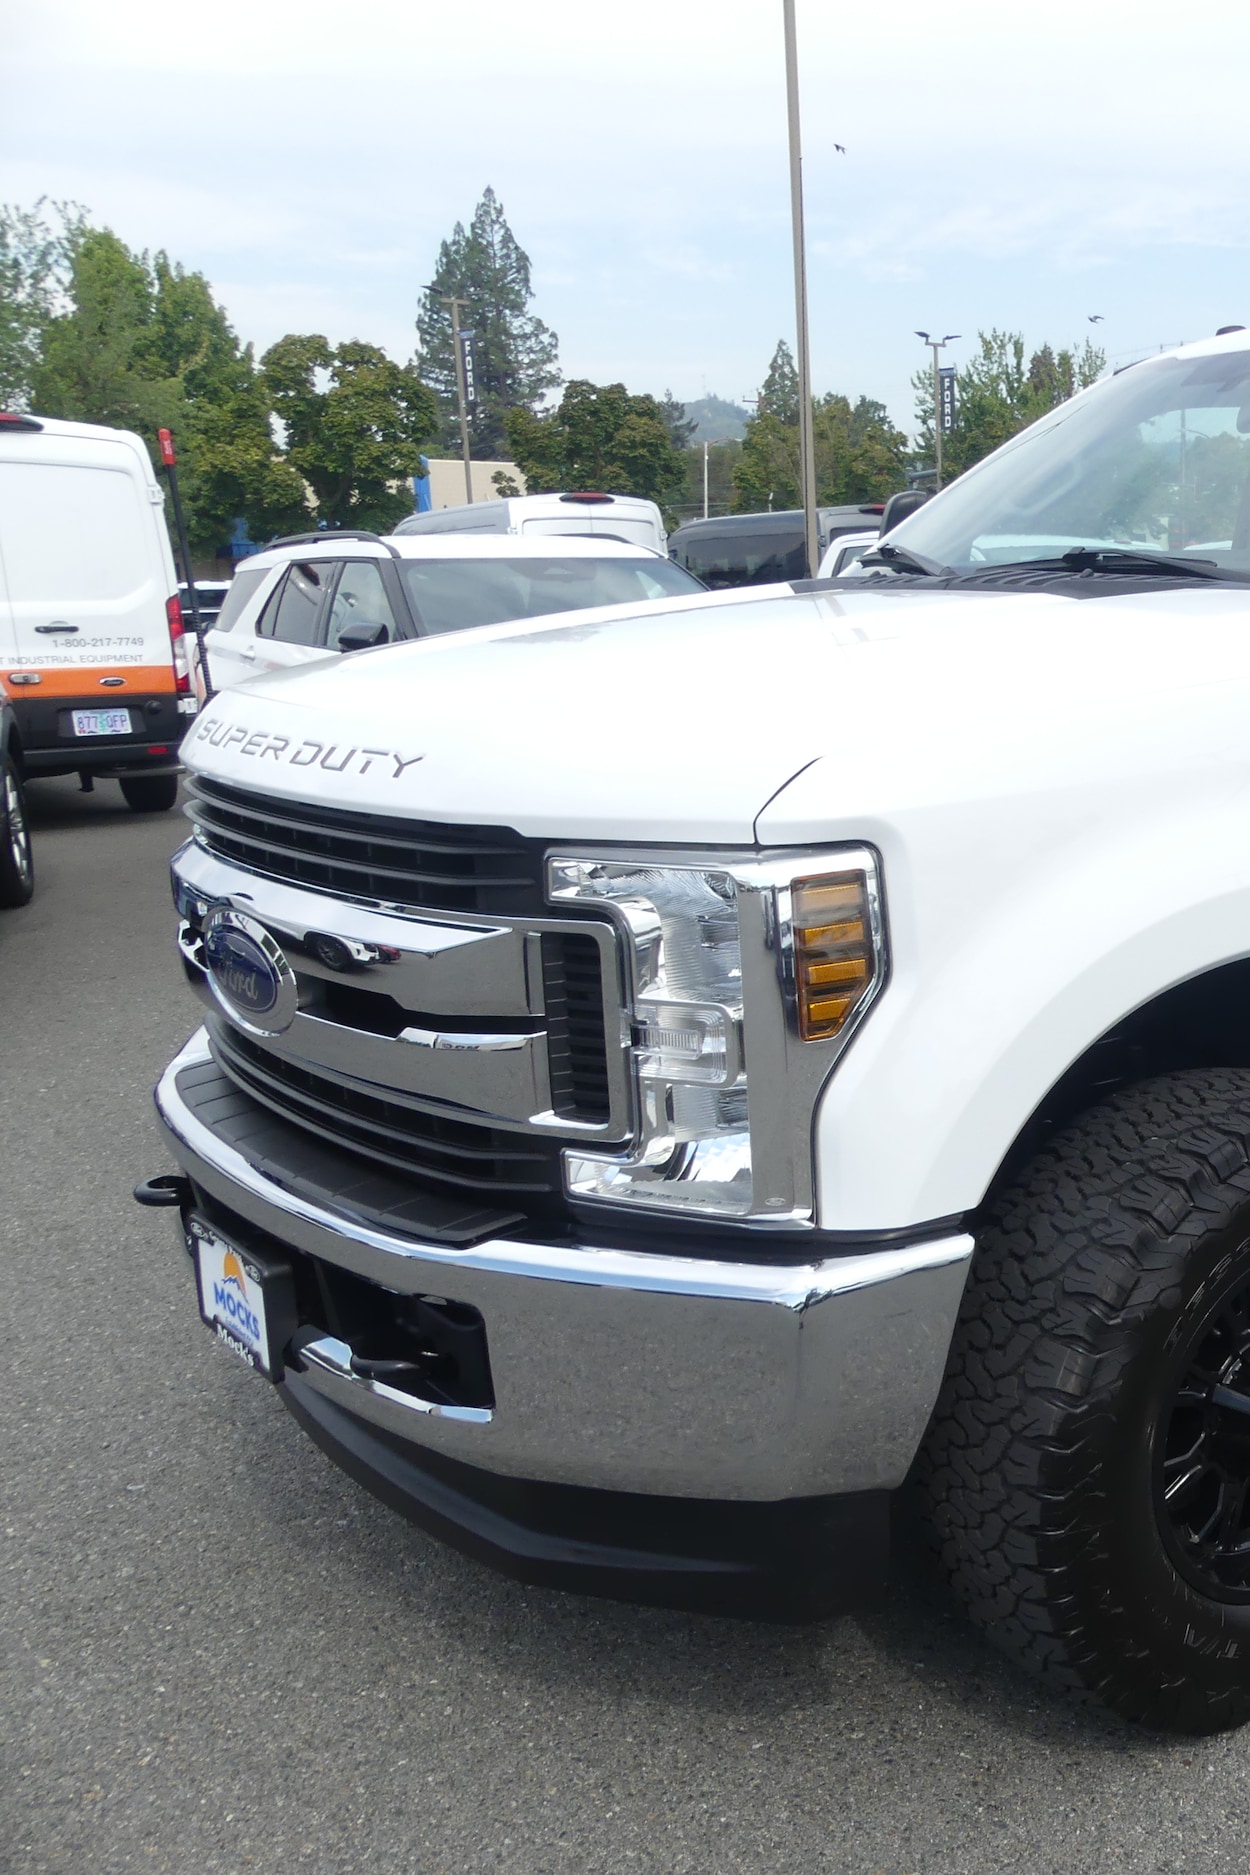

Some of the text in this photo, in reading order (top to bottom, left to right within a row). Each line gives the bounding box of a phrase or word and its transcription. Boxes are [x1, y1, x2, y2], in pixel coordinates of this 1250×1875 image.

[464, 341, 474, 401] FORD
[943, 377, 952, 428] FORD
[8, 655, 76, 665] INDUSTRIAL
[80, 654, 144, 664] EQUIPMENT
[52, 637, 145, 648] 1-800-217-7749
[77, 715, 98, 730] 877
[197, 718, 425, 779] SUPER DUTY
[213, 1280, 261, 1341] MOCKS
